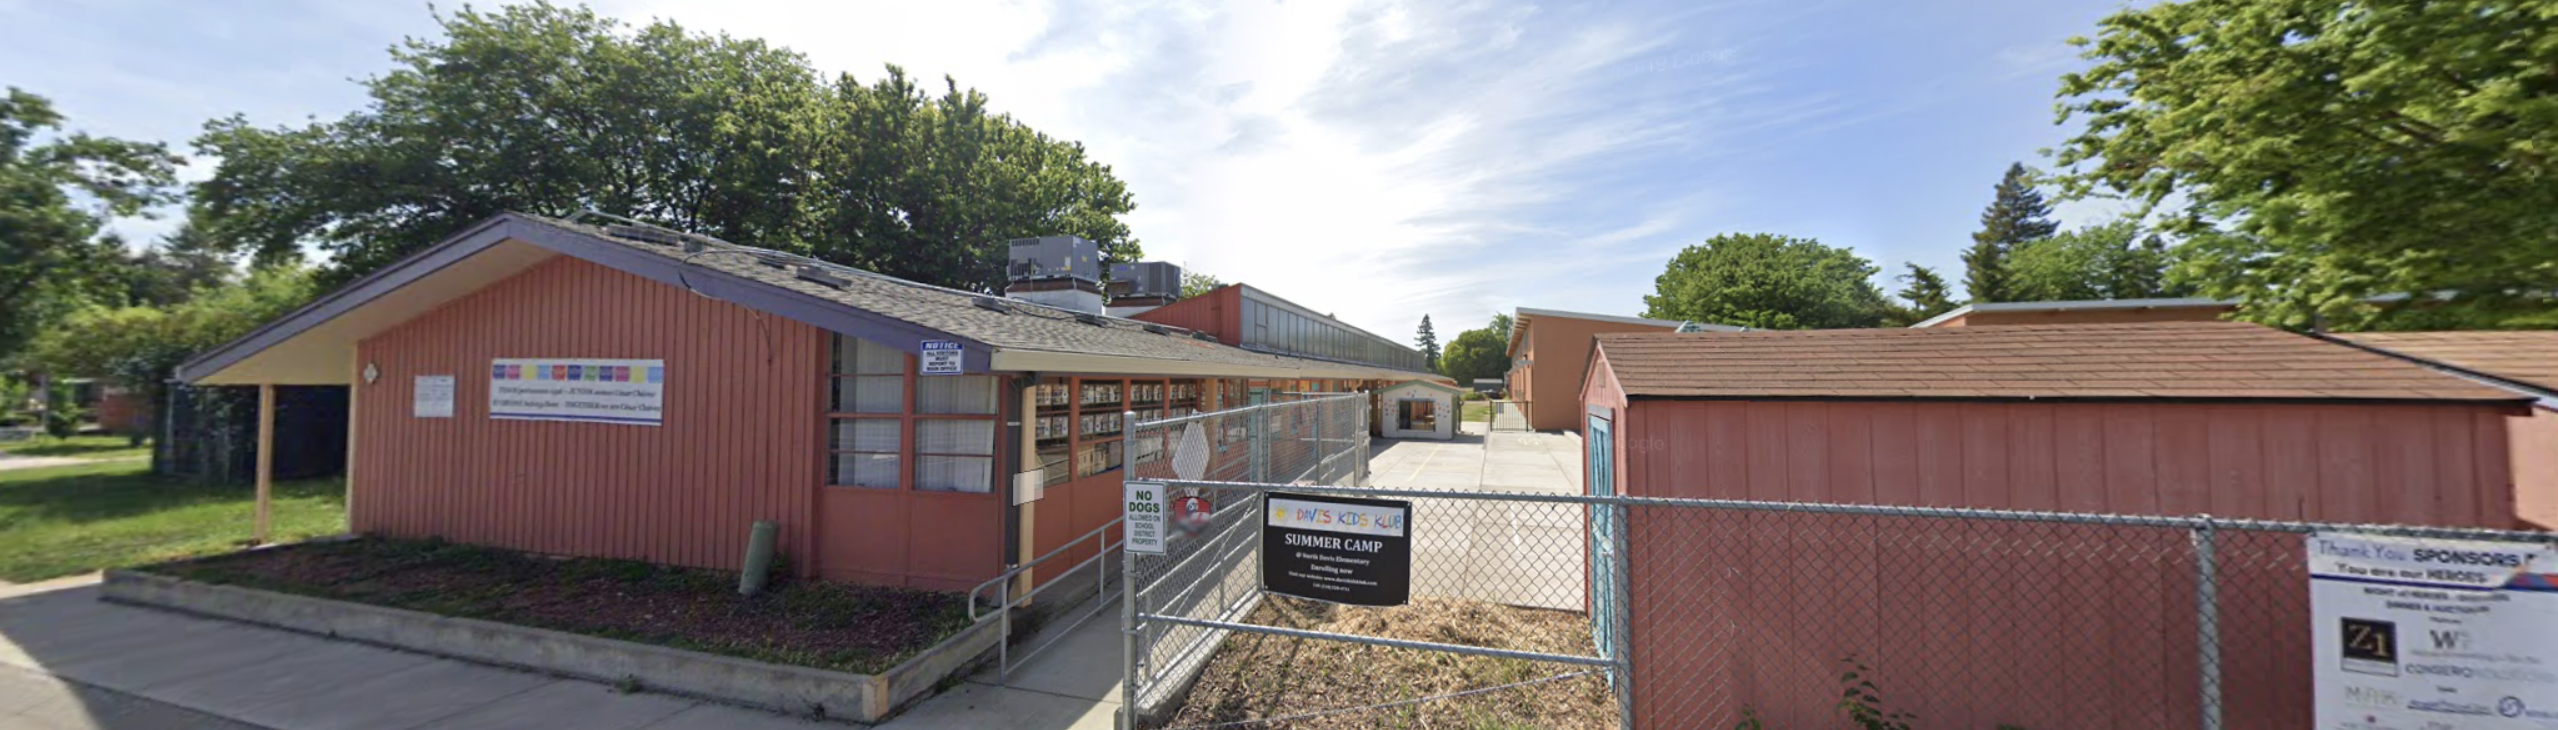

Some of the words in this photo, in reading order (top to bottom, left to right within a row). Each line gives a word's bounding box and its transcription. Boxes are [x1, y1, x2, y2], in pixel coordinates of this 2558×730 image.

[1136, 490, 1152, 501] NO
[1129, 502, 1160, 513] DOGS
[1296, 508, 1332, 524] DAVIS
[1337, 511, 1369, 527] KIDS
[1374, 513, 1403, 529] KLUB
[1135, 522, 1154, 530] SCHOOL
[1134, 530, 1155, 538] DISTRICT
[1132, 538, 1158, 546] PROPERTY
[1284, 532, 1342, 550] SUMMER
[1344, 538, 1383, 553] CAMP
[1302, 552, 1318, 560] North
[1319, 554, 1335, 562] Davis
[1335, 556, 1370, 566] Elementary
[2316, 539, 2370, 560] Thank
[2371, 543, 2407, 562] You
[2412, 548, 2520, 567] SPONSORS
[1310, 563, 1339, 575] Enrolling
[1339, 567, 1354, 575] now
[2335, 561, 2367, 575] You
[2370, 567, 2394, 578] are
[2399, 569, 2423, 579] our
